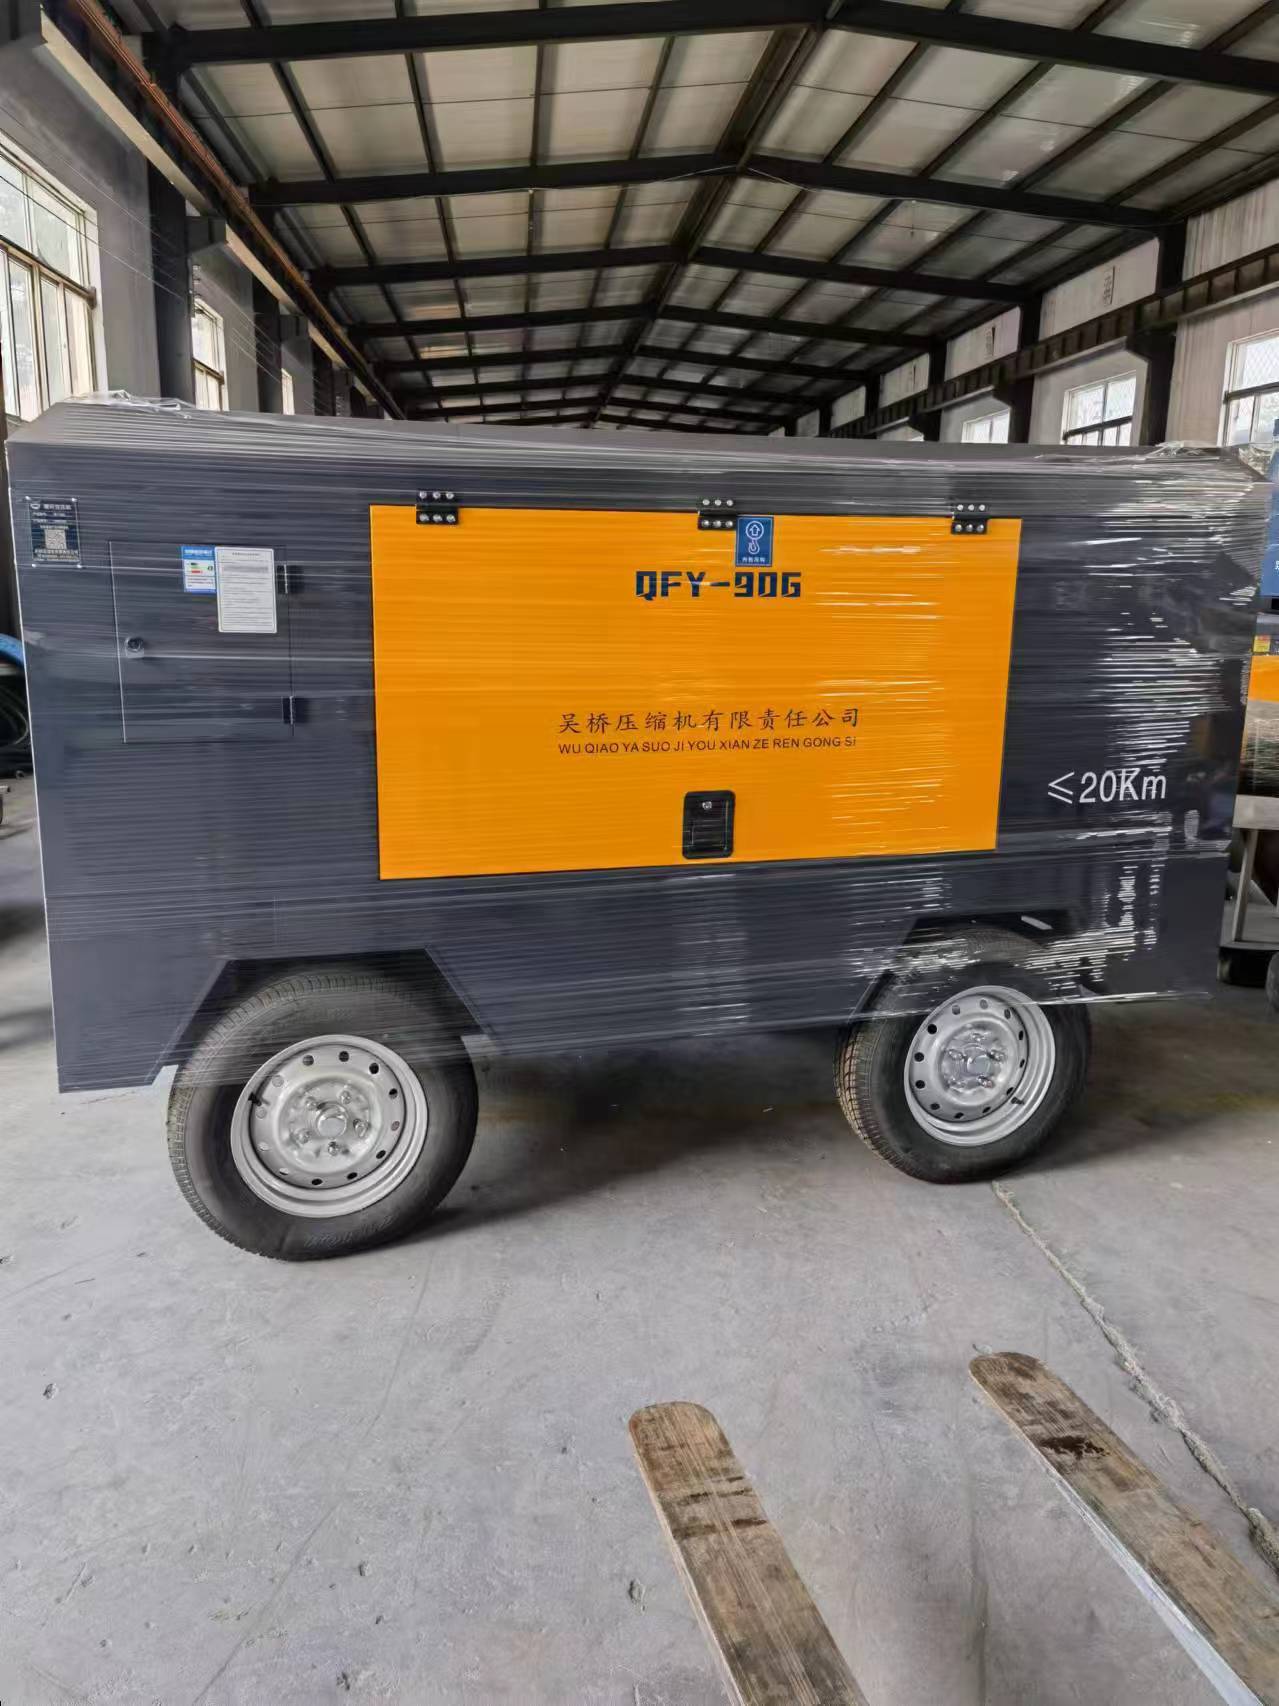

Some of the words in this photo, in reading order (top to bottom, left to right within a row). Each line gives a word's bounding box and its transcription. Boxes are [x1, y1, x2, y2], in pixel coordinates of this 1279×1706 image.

[636, 571, 801, 600] QFY-90G
[559, 707, 859, 734] 吴桥压缩机有限责任公司
[558, 743, 581, 755] WU
[584, 742, 619, 754] QIAO
[622, 742, 640, 753] YA
[642, 741, 671, 752] SUO
[674, 741, 684, 752] JI
[687, 740, 716, 751] YOU
[719, 739, 750, 750] XIAN
[752, 738, 769, 749] ZE
[773, 738, 800, 748] REN
[803, 737, 841, 748] GONG
